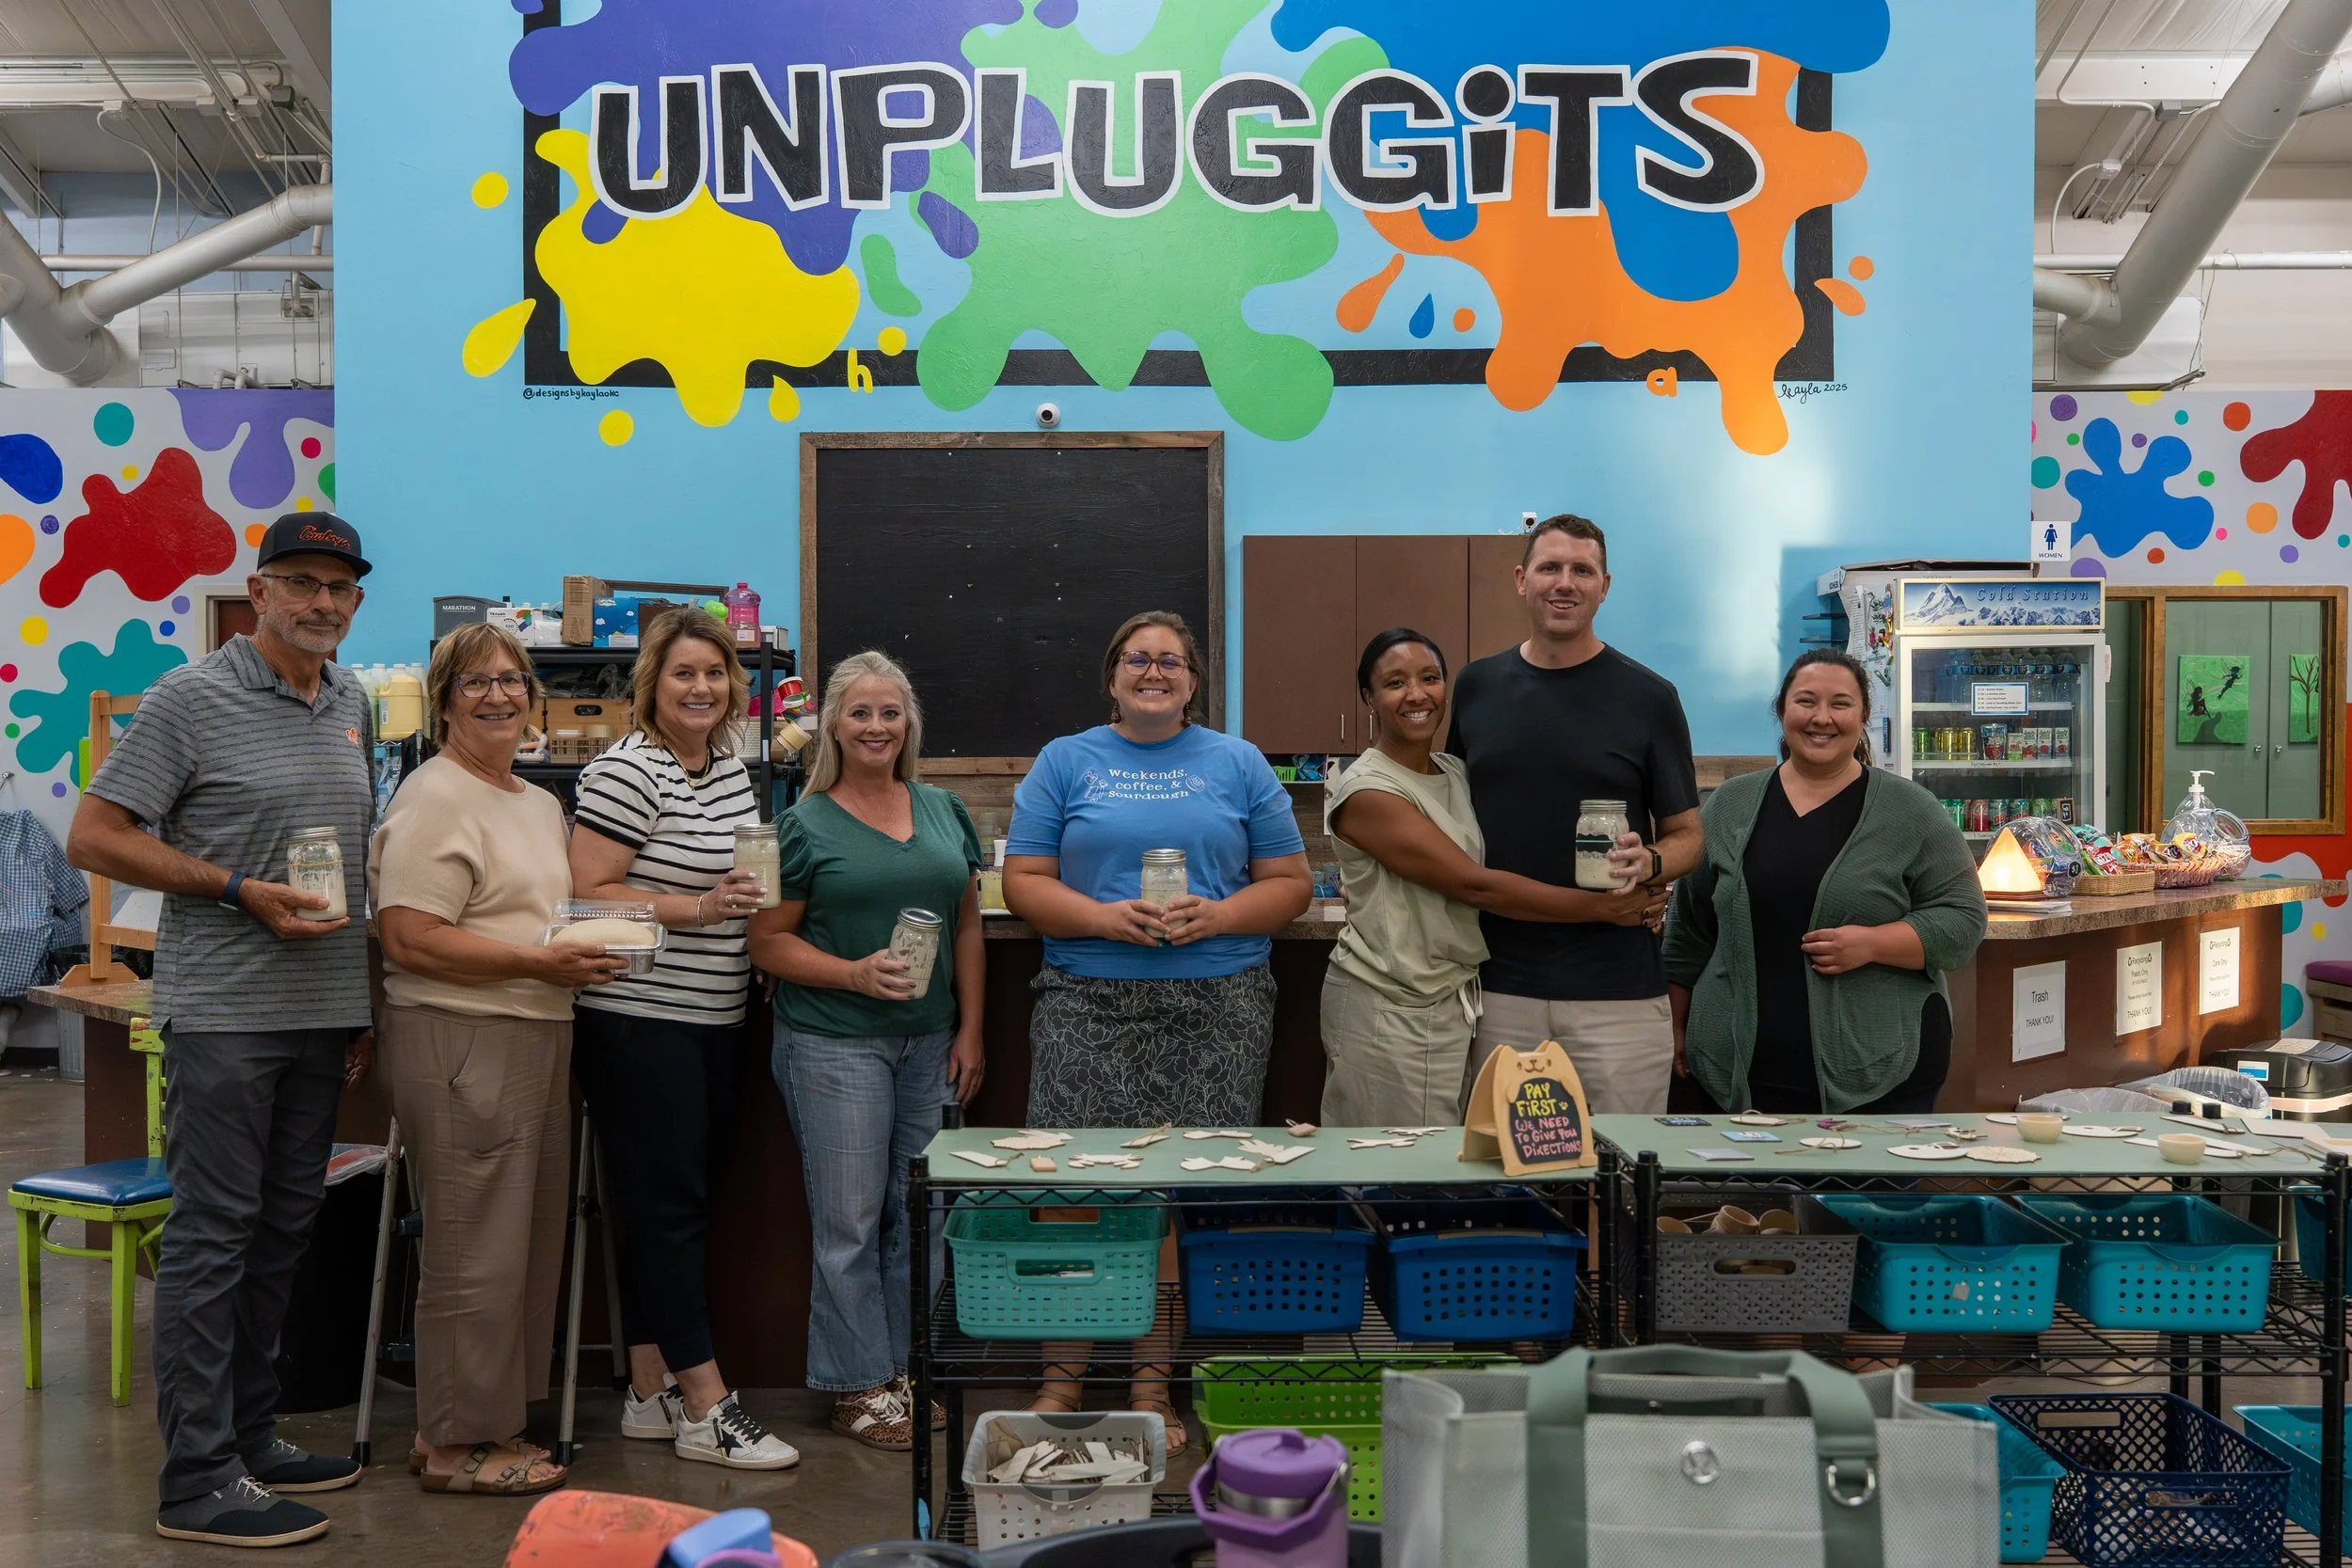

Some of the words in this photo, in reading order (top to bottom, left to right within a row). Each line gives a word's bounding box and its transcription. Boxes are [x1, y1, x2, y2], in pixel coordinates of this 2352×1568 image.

[848, 347, 873, 393] h
[1646, 367, 1677, 397] a
[1823, 383, 1848, 392] 2025
[1977, 585, 2016, 601] Cold
[2023, 588, 2090, 601] Station
[1170, 780, 1183, 789] &
[2032, 990, 2049, 1004] Trash
[2026, 1018, 2042, 1028] THANK
[1524, 1082, 1550, 1100] PAY
[1538, 1117, 1569, 1128] NEED
